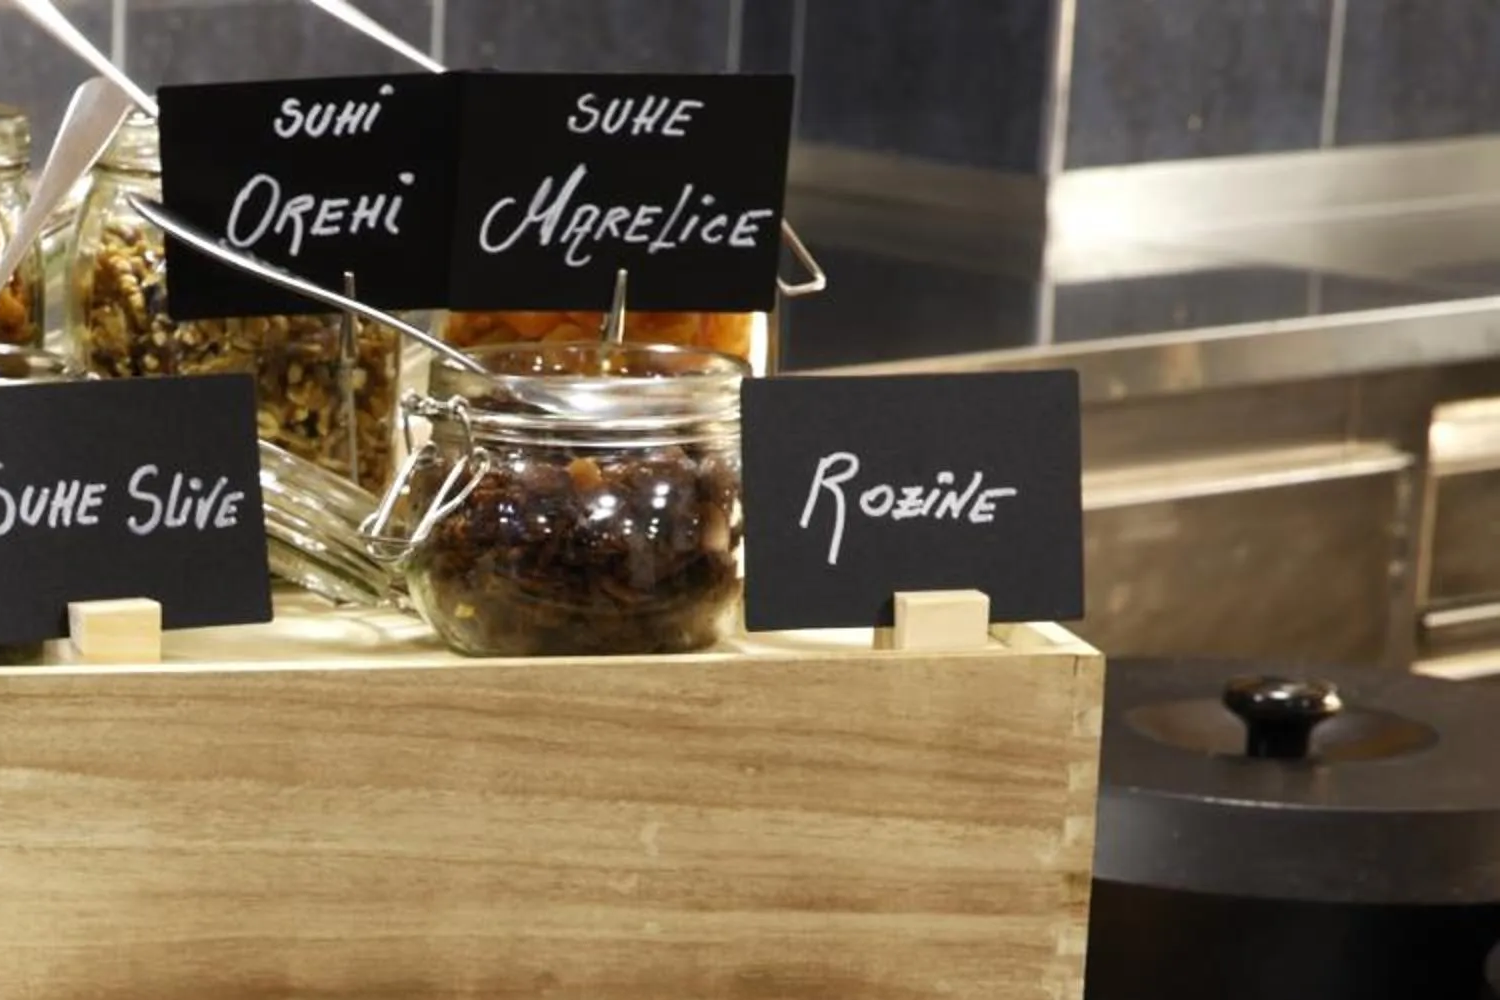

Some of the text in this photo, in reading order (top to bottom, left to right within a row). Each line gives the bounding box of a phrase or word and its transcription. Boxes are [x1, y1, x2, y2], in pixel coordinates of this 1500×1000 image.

[274, 84, 394, 138] SUHI
[567, 93, 704, 136] SUHE
[226, 172, 414, 256] OREHI
[480, 165, 773, 267] MARELICE
[127, 464, 245, 535] SLIVE
[799, 451, 1018, 565] ROZINE
